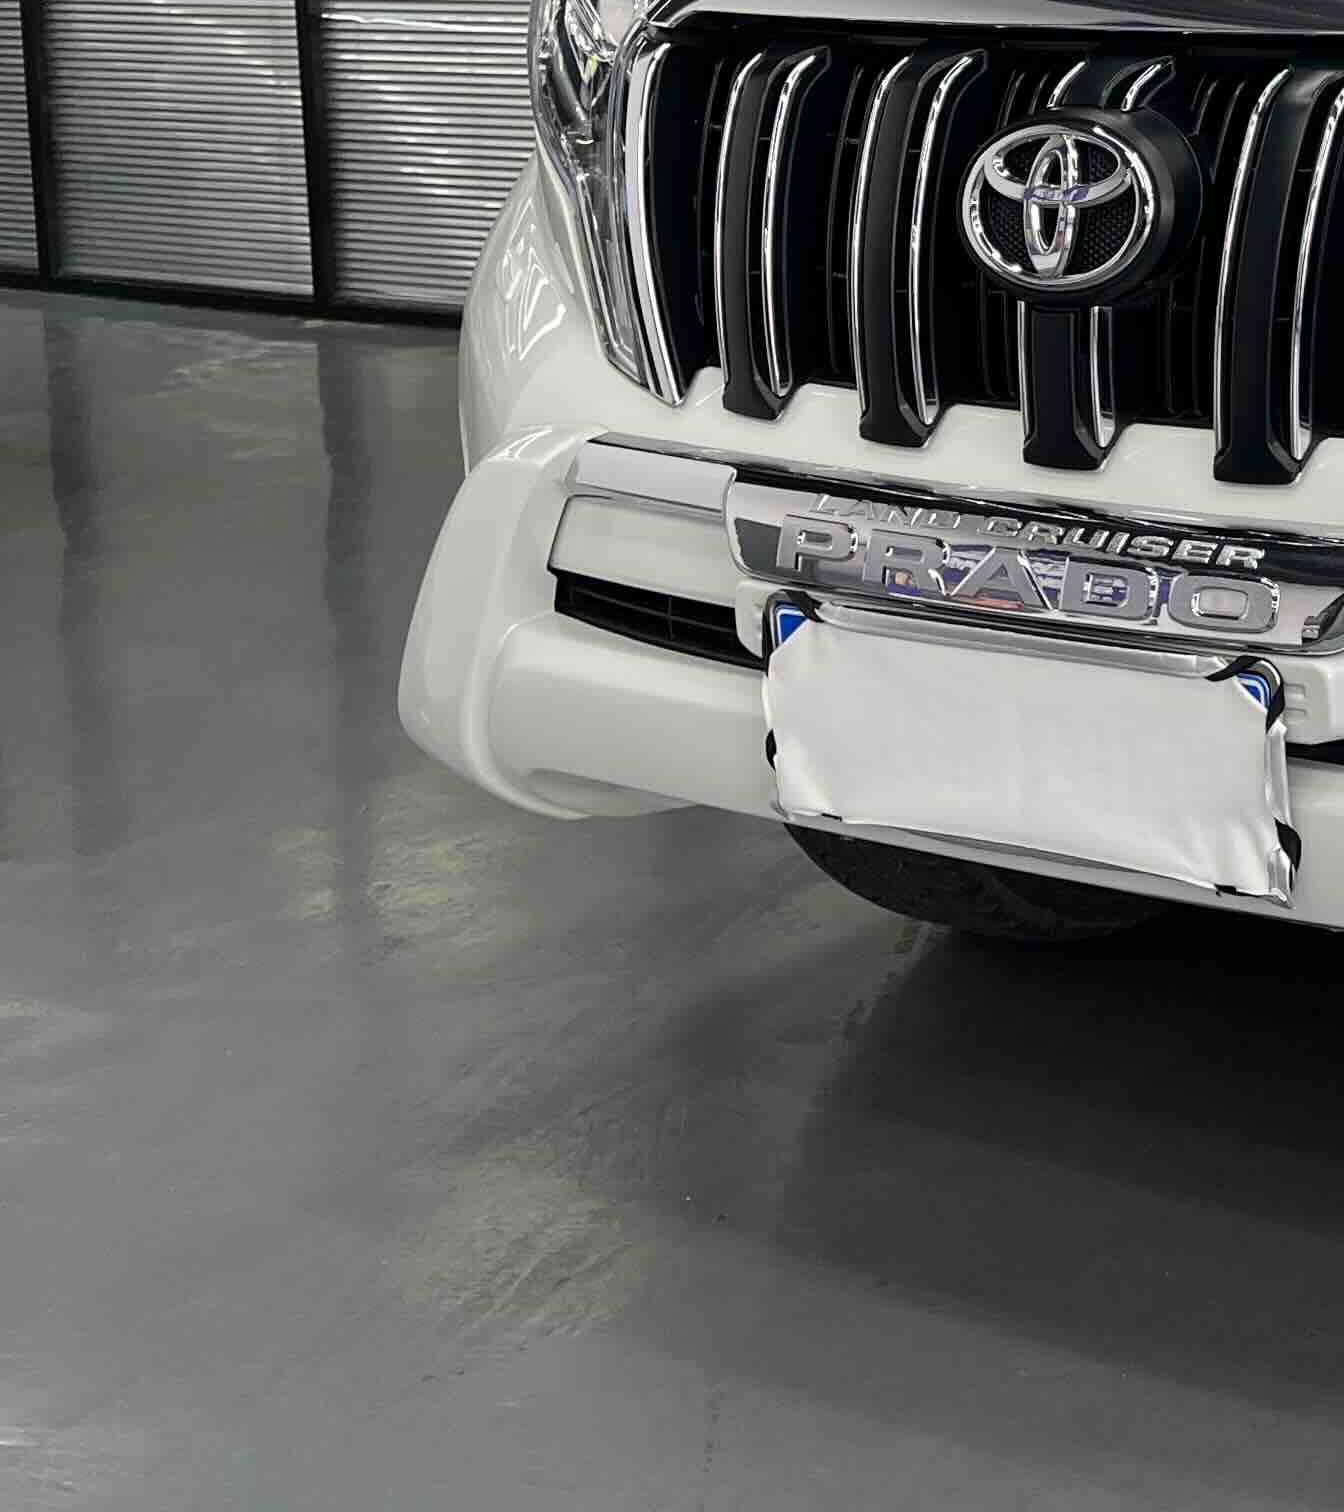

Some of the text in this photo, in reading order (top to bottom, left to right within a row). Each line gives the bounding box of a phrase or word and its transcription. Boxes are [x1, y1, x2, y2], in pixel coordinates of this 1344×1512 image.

[778, 514, 1280, 632] PRADO
[808, 494, 1266, 570] LAND CRUISER
